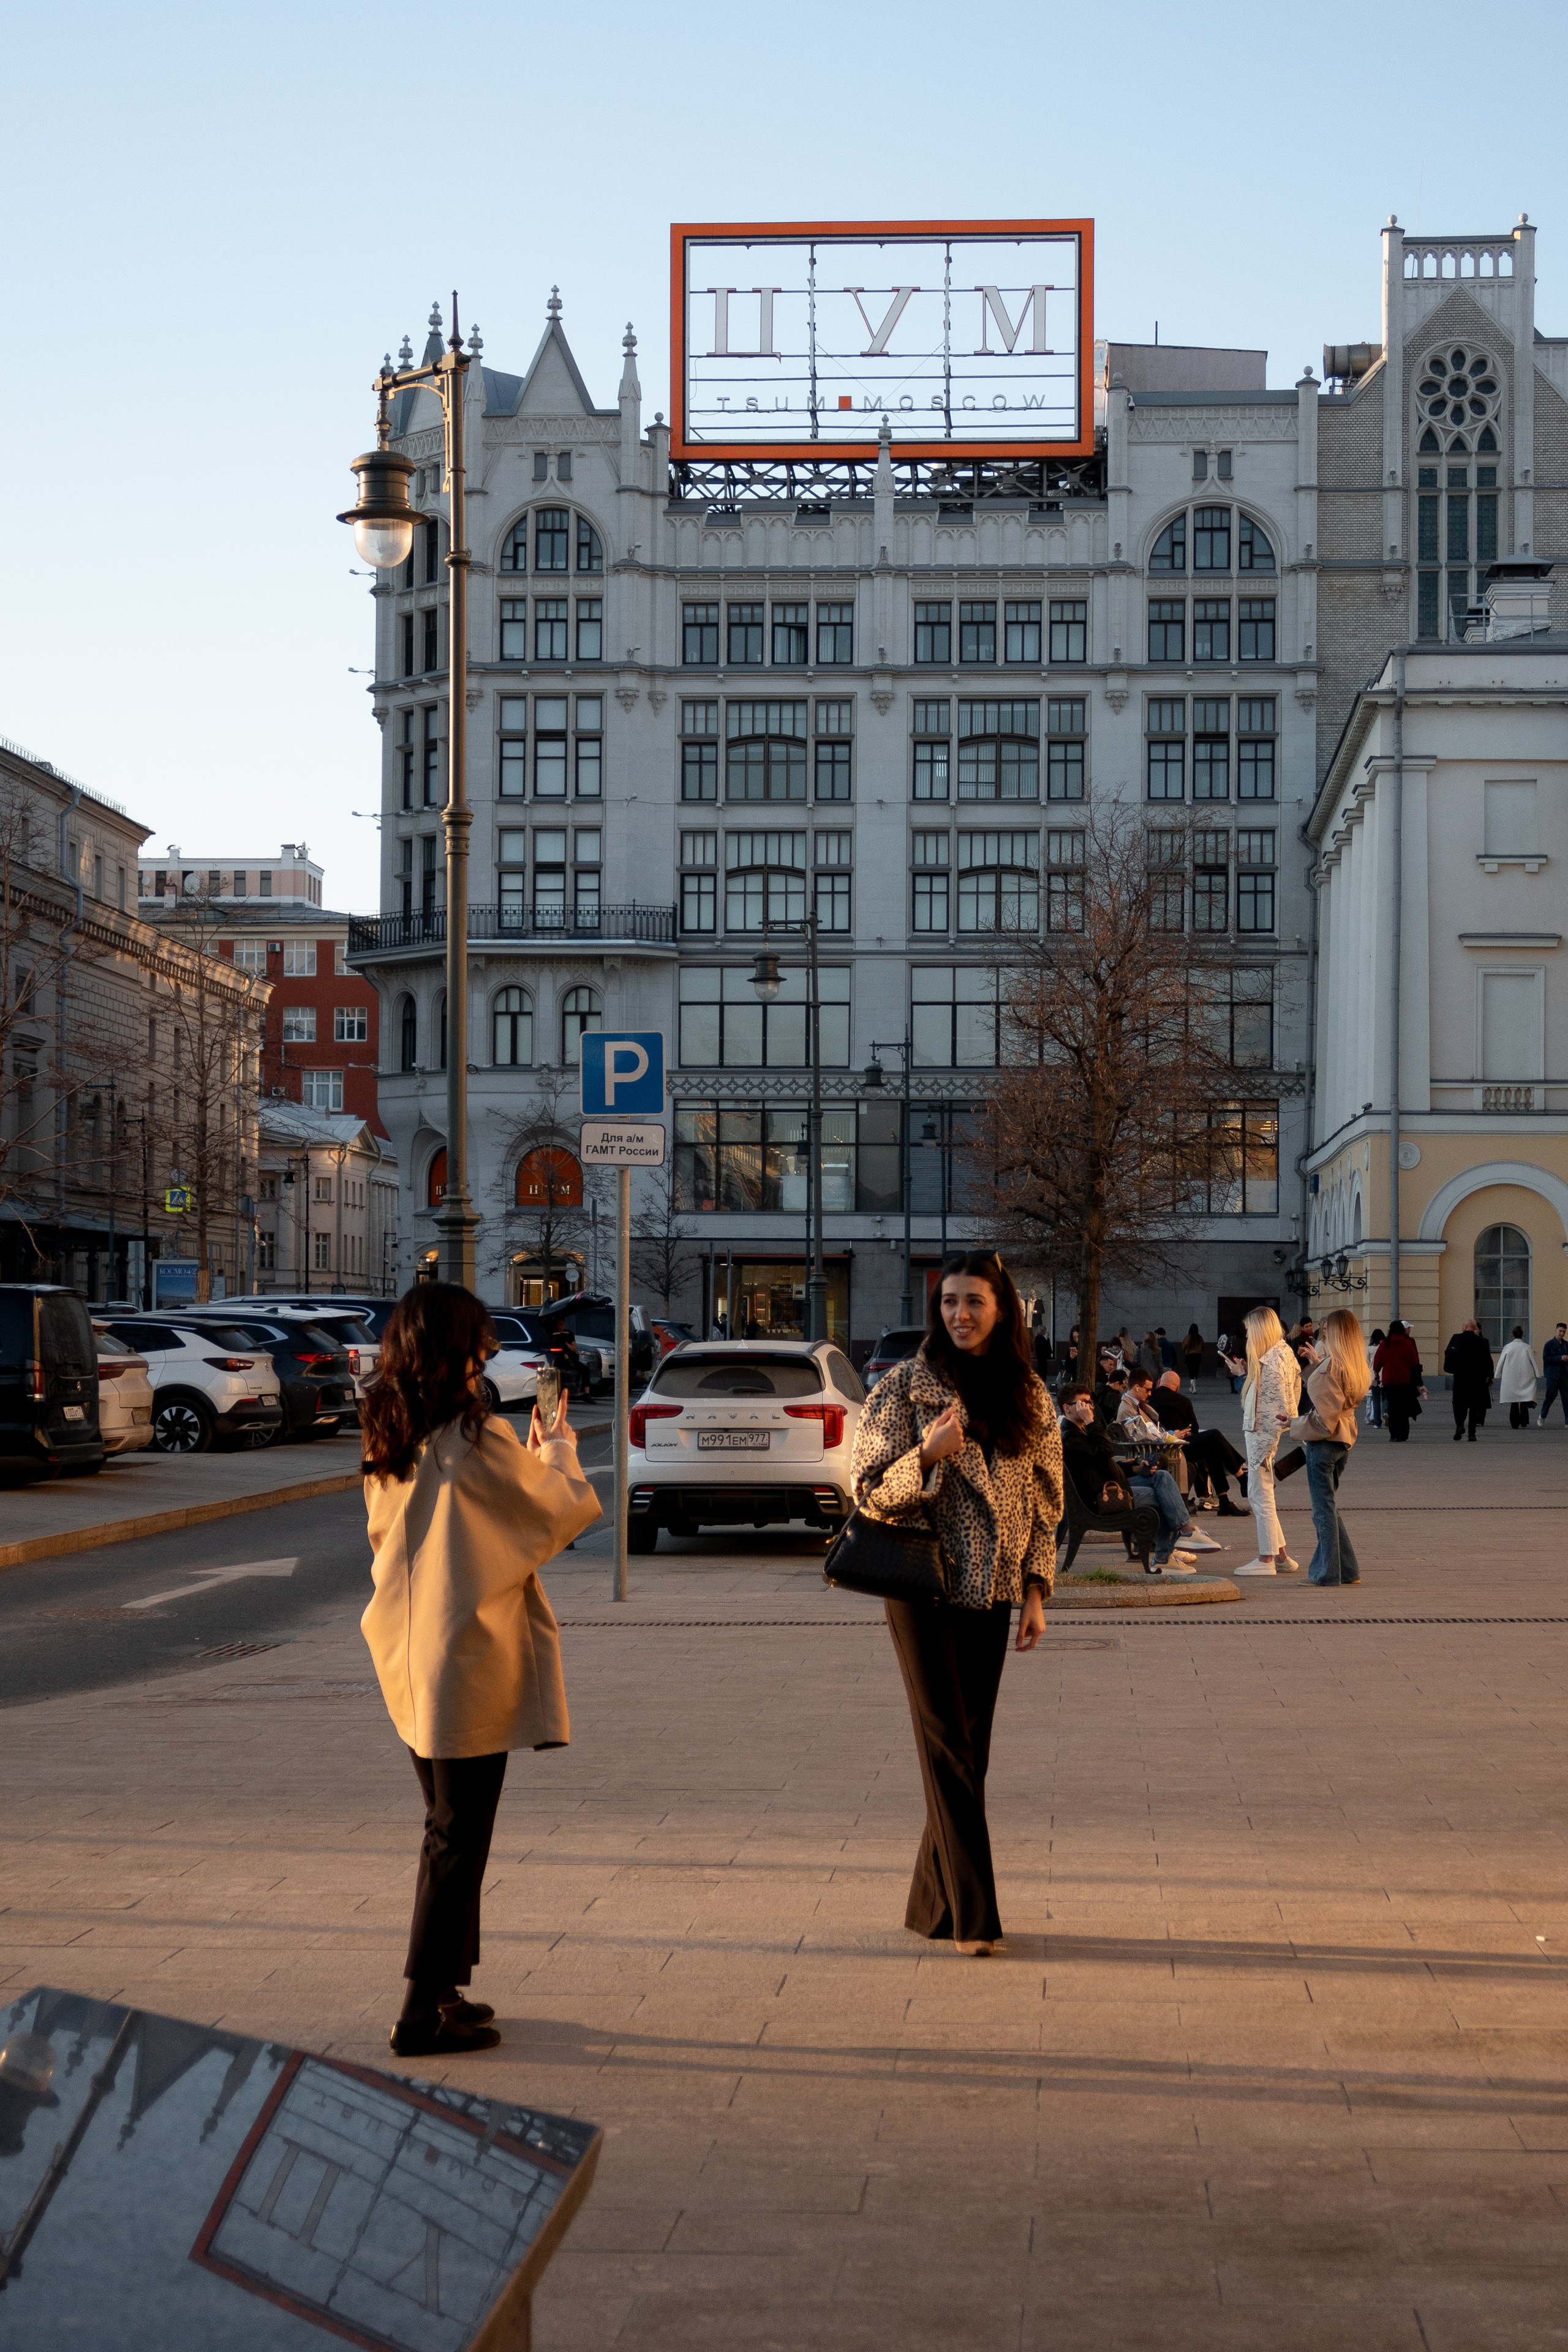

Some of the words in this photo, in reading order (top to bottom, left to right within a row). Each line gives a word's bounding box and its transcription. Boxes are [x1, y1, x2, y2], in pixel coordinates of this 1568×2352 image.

[706, 285, 1055, 364] ЦУМ
[717, 396, 827, 411] TSUM
[863, 394, 1046, 410] MOSCOW
[605, 1041, 649, 1106] P
[601, 1133, 623, 1143] Для
[626, 1134, 644, 1143] а/м
[586, 1145, 616, 1155] ГАМТ
[619, 1146, 659, 1156] России
[529, 1185, 571, 1195] ЦМ
